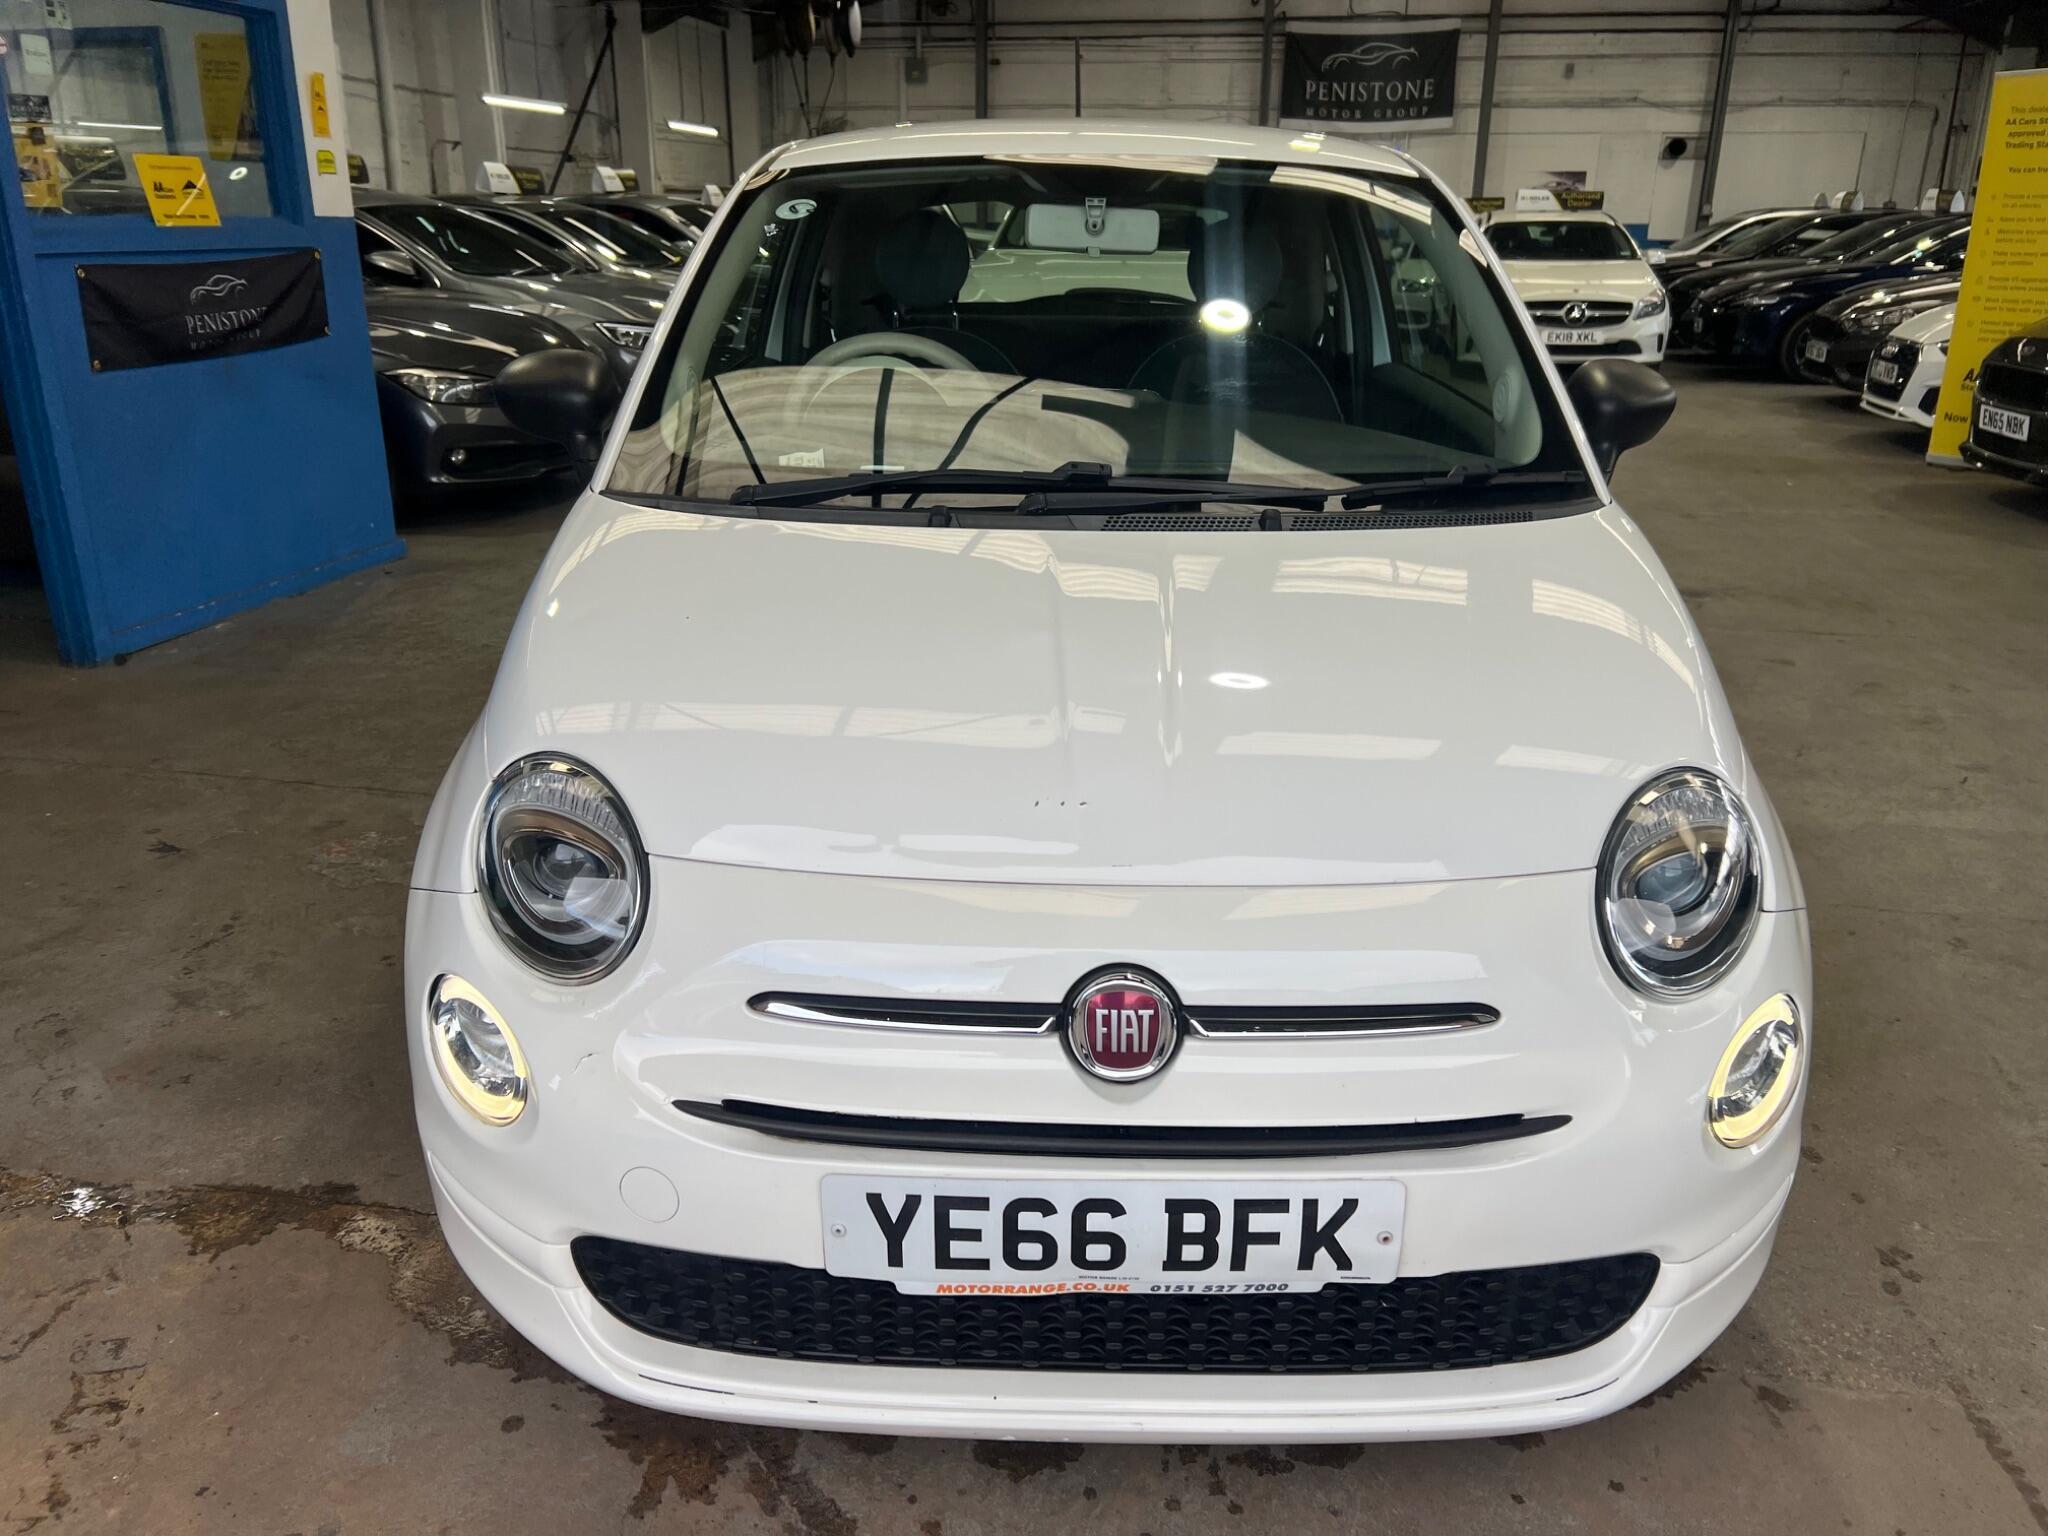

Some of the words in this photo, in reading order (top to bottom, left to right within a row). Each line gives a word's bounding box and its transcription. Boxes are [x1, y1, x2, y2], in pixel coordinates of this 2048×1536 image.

[1305, 79, 1435, 102] PENISTONE
[1306, 107, 1362, 119] MOTOR
[1373, 105, 1429, 118] GROUP
[185, 307, 267, 335] PENISTON
[1547, 331, 1573, 343] EK18
[1577, 331, 1597, 343] XKL
[1944, 412, 1969, 424] Now
[1983, 408, 2004, 431] EN65
[2006, 414, 2026, 437] NBK
[1095, 1008, 1154, 1053] FIAT
[866, 1193, 1127, 1271] YE66
[1162, 1198, 1358, 1272] BFK
[936, 1282, 1130, 1294] MOTORRANGE.CO.UK
[1150, 1284, 1194, 1293] 0151
[1201, 1284, 1239, 1293] 527
[1241, 1283, 1290, 1293] 7000
